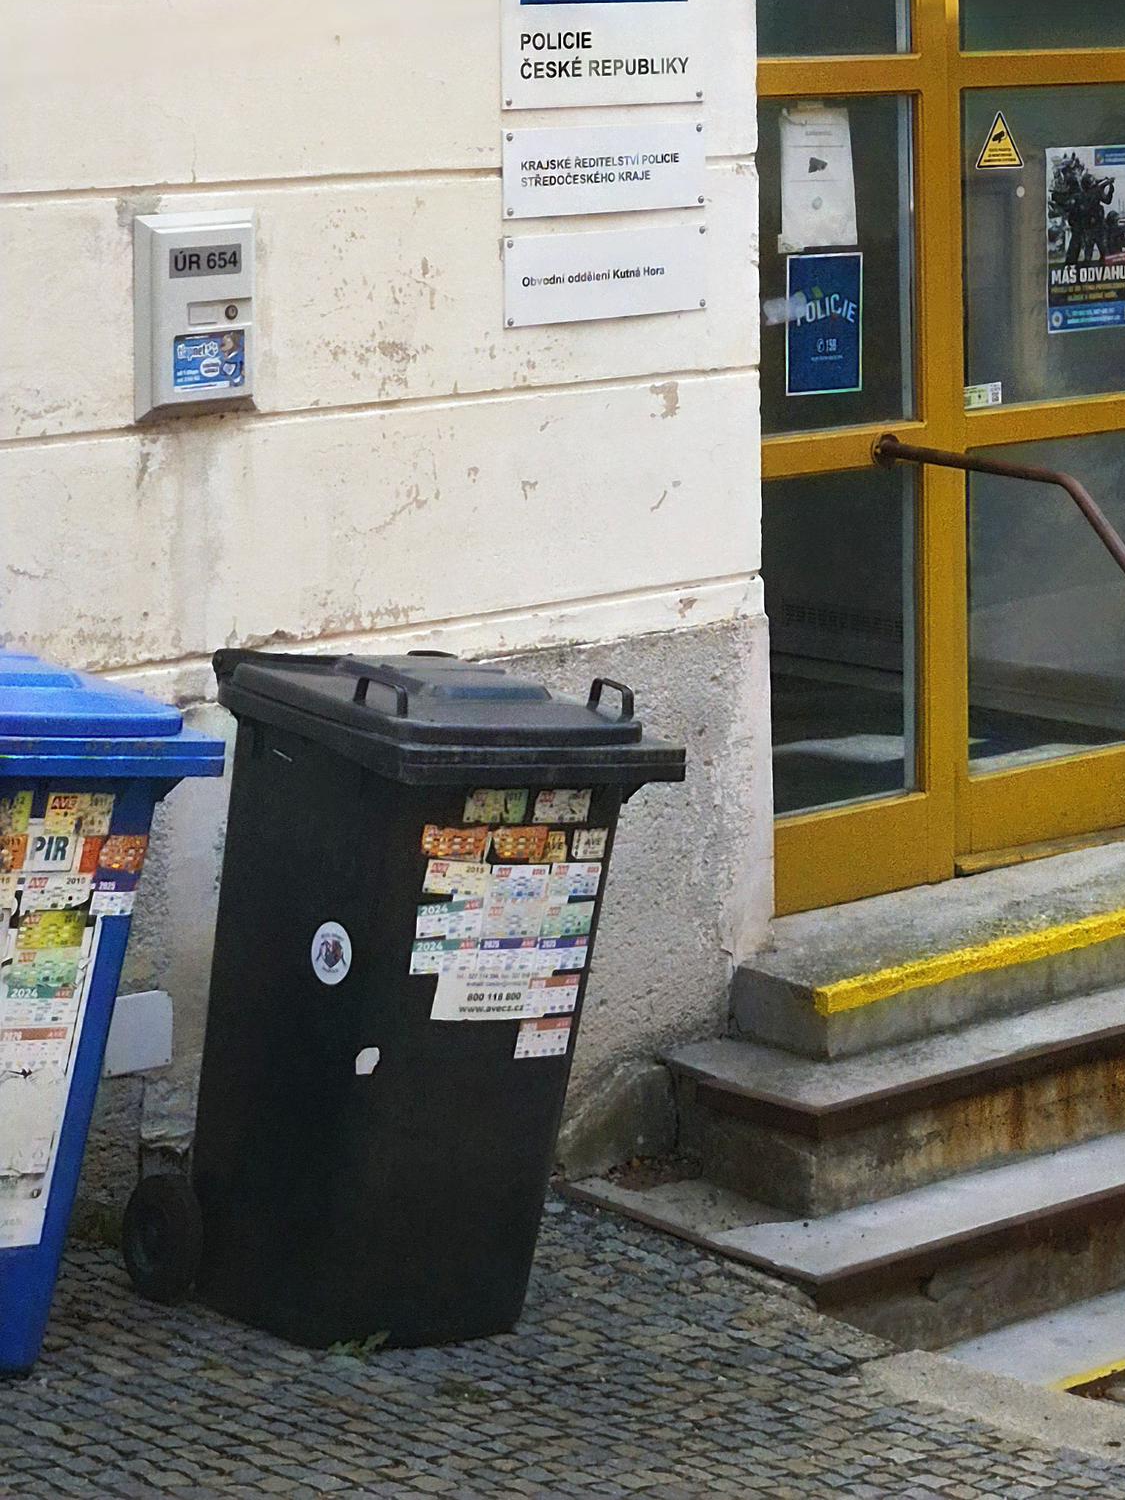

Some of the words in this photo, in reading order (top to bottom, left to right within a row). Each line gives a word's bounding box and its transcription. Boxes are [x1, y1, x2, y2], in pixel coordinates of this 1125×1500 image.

[520, 31, 593, 51] POLICIE
[520, 56, 583, 80] ČESKÉ
[588, 56, 690, 77] REPUBLIKY
[520, 156, 572, 171] KRAJSKÉ
[574, 153, 640, 169] ŘEDITELSTVÍ
[641, 152, 680, 165] POLICIE
[520, 170, 616, 188] STŘEDOČESKÉHO
[618, 169, 651, 182] KRAJE
[174, 251, 201, 272] ÚR
[206, 250, 239, 270] 654
[612, 266, 641, 279] Kutná
[642, 265, 666, 276] Hora
[1051, 264, 1077, 285] MÁŠ
[29, 835, 70, 861] PIR
[421, 904, 449, 916] 2024
[416, 941, 444, 952] 2024
[10, 987, 39, 998] 2024
